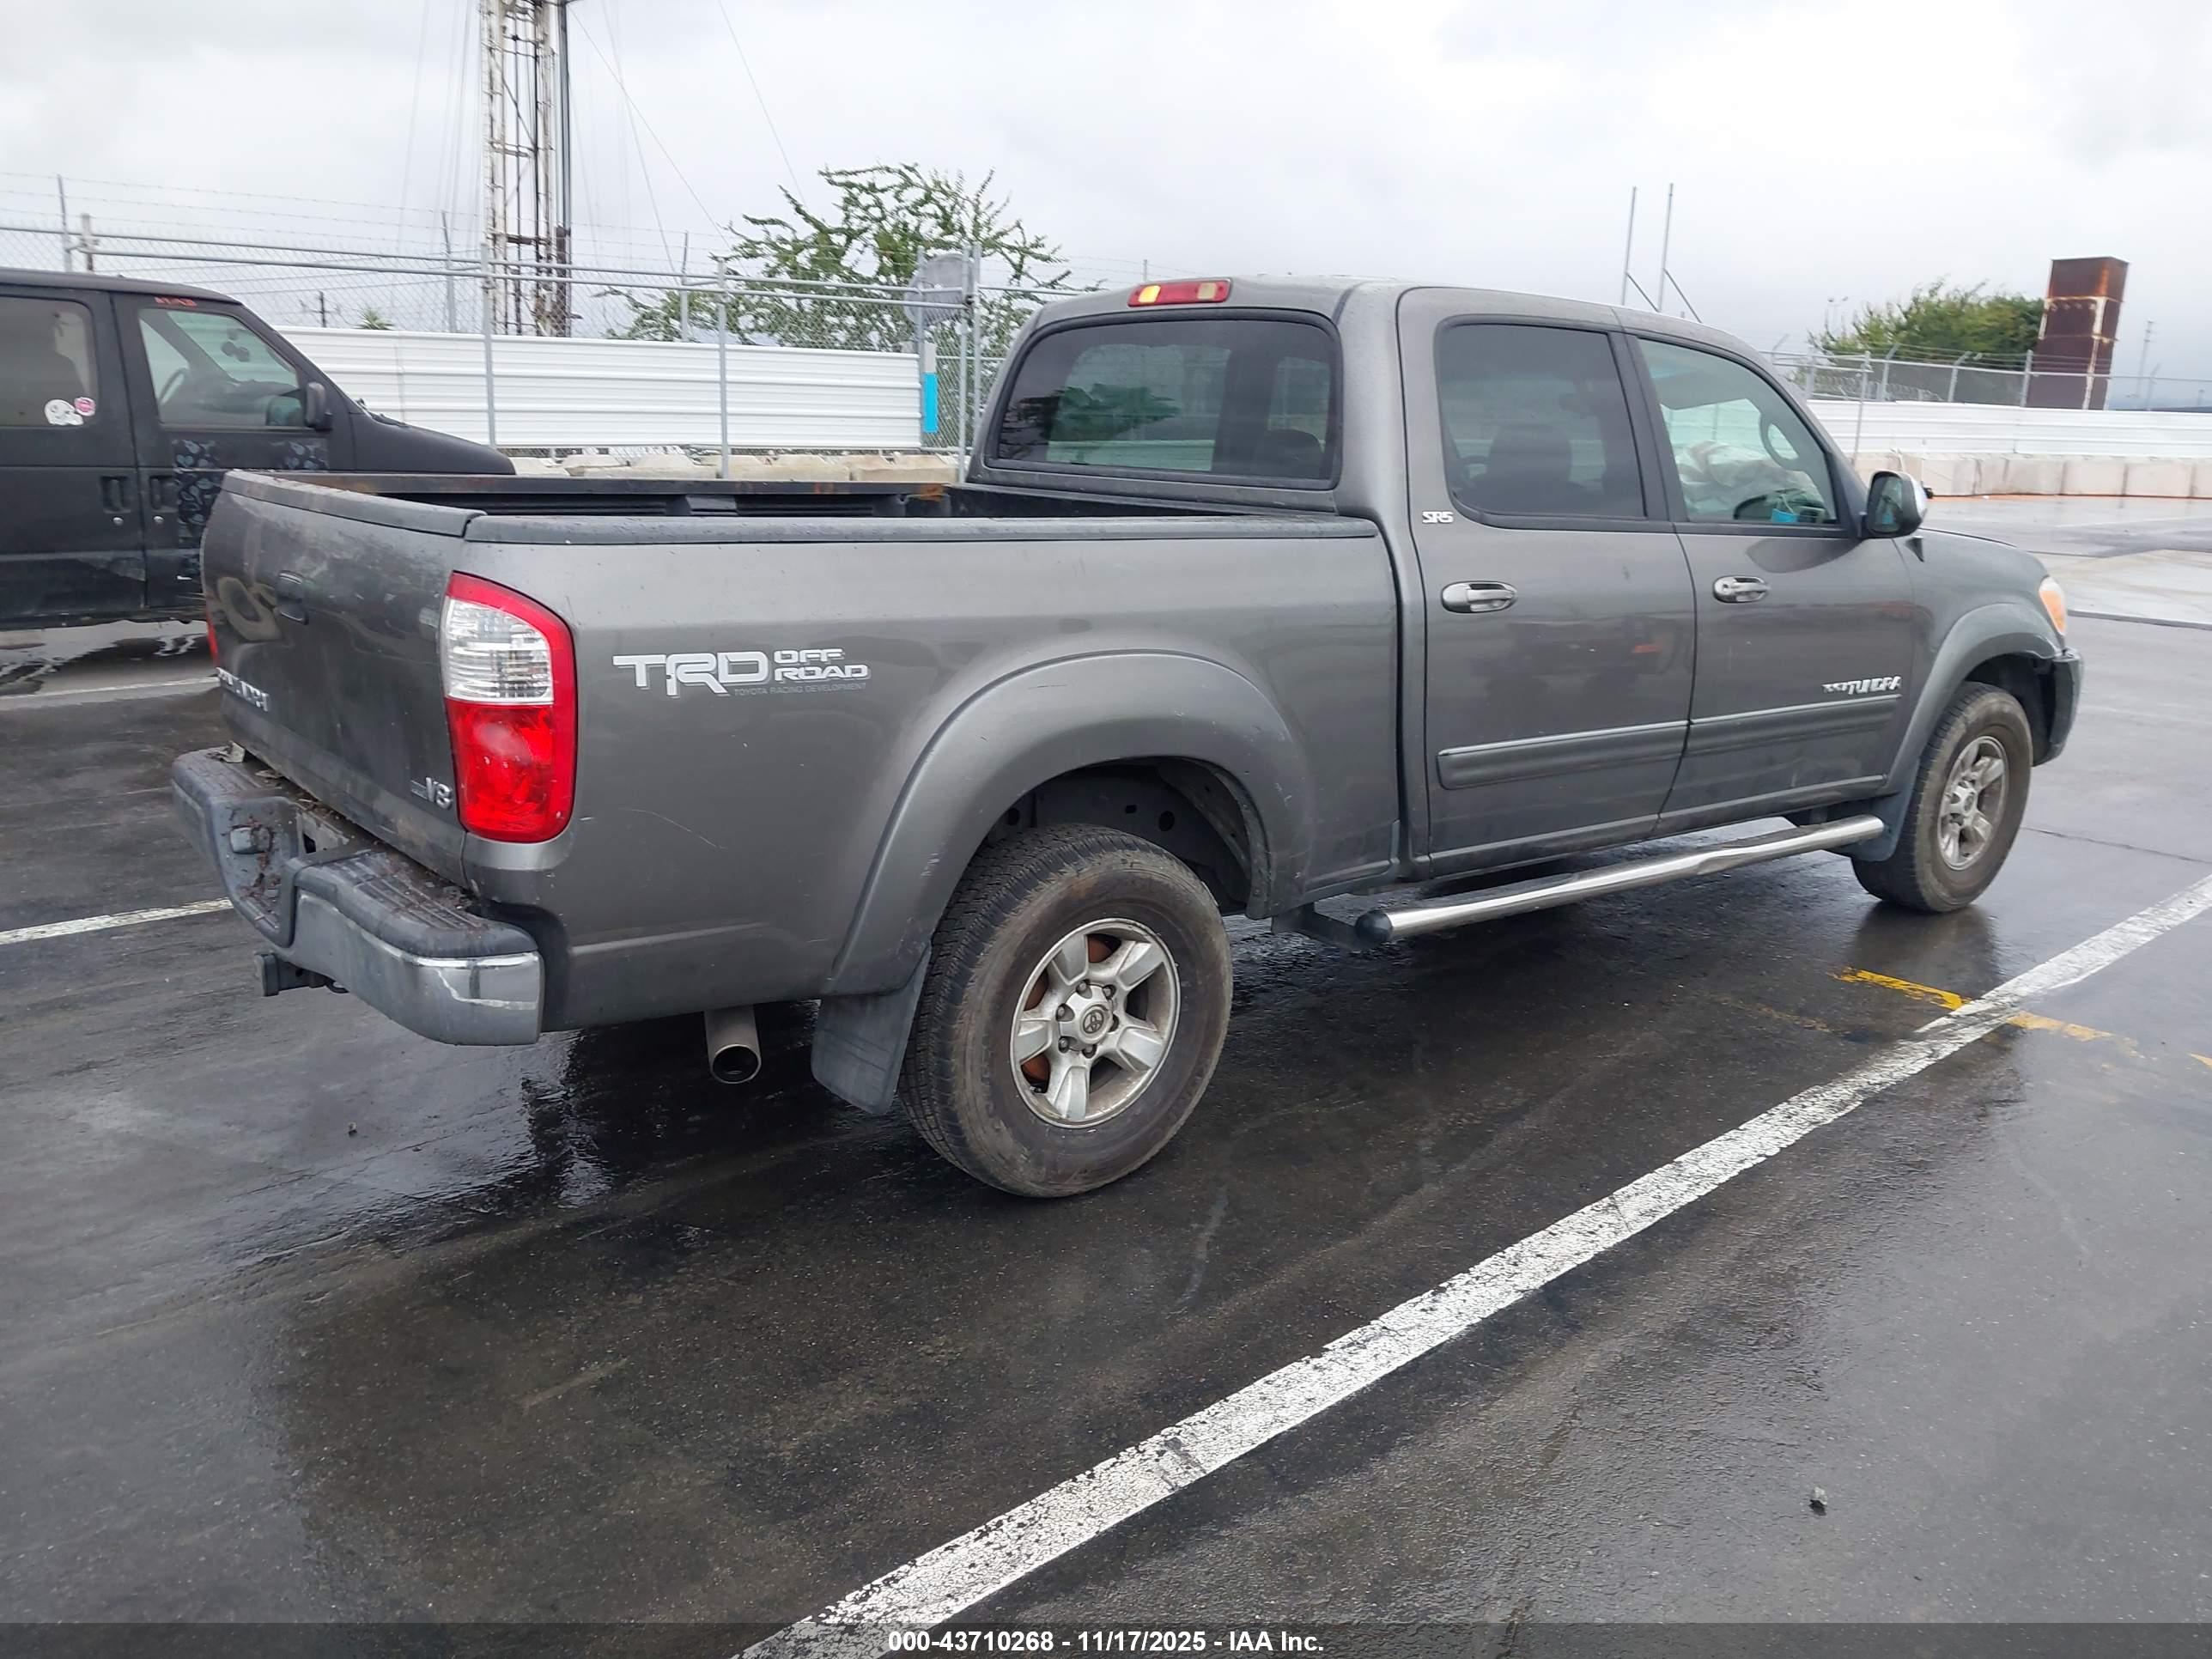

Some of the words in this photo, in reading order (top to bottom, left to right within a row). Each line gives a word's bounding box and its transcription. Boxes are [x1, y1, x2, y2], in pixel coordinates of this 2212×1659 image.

[774, 648, 843, 664] OFF
[612, 651, 769, 697] TRD
[774, 664, 869, 681] ROAD
